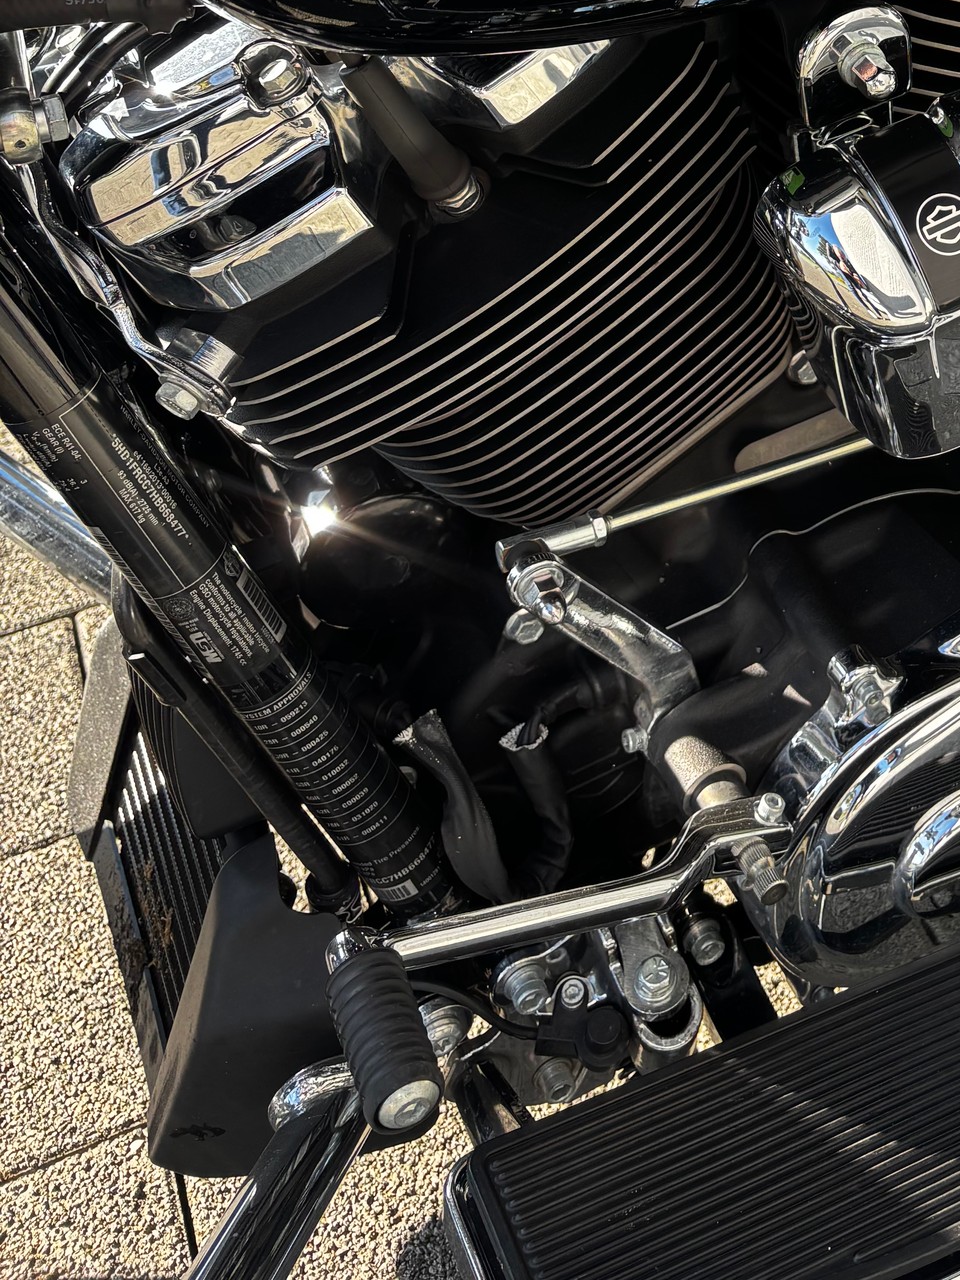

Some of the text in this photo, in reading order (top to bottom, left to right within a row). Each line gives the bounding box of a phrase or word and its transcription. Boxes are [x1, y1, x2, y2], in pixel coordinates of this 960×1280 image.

[41, 426, 60, 447] GEAR
[50, 422, 66, 439] ECE
[116, 469, 127, 480] 93
[118, 404, 210, 528] HARLEY-DAVIDSON MOTOR COMPANY
[121, 477, 139, 497] dB(A)
[118, 487, 133, 504] MAX
[136, 513, 147, 524] kg
[197, 582, 211, 598] GSO
[206, 595, 233, 629] motorcycle
[227, 626, 254, 659] regulations.
[204, 577, 256, 647] conforms to all applicable
[211, 571, 222, 585] The
[217, 582, 244, 616] motorcycle
[241, 615, 257, 634] motor
[252, 632, 271, 654] tricycle
[187, 588, 207, 611] Engine
[201, 607, 233, 648] Displacement:
[229, 644, 243, 659] 1745
[238, 657, 247, 666] cc
[244, 671, 311, 718] YSTEM APPROVALS
[280, 700, 307, 722] 059213
[290, 714, 318, 737] 000540
[300, 729, 328, 752] 000425
[311, 744, 338, 766] 040176
[321, 758, 349, 780] 010032
[331, 772, 358, 794] 000052
[351, 800, 378, 822] 031020
[361, 815, 387, 835] 000411
[373, 855, 388, 864] Tire
